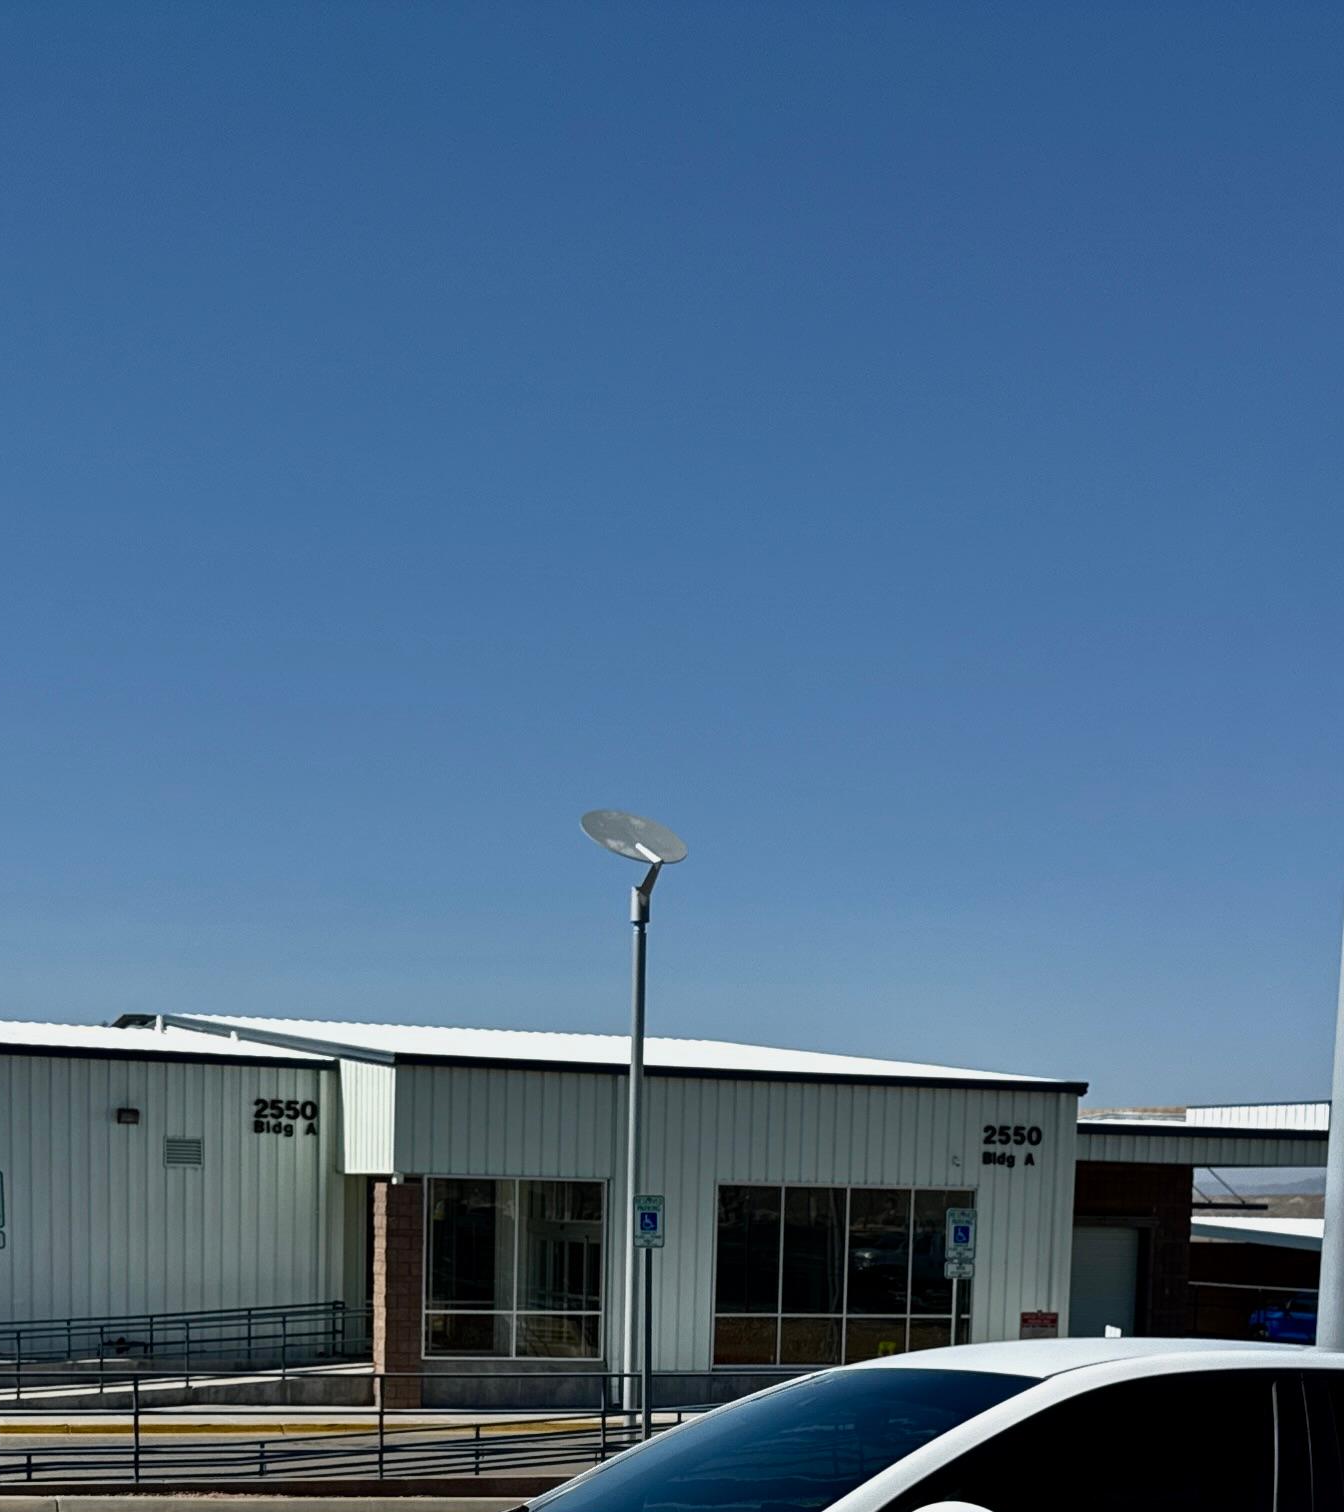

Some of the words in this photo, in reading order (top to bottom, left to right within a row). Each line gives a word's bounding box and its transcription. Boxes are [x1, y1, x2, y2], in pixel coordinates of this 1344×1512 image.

[253, 1098, 318, 1120] 2550
[253, 1120, 294, 1137] Bldg
[305, 1122, 317, 1135] A
[982, 1124, 1042, 1146] 2550
[982, 1151, 1016, 1168] Bldg
[1024, 1152, 1035, 1166] A
